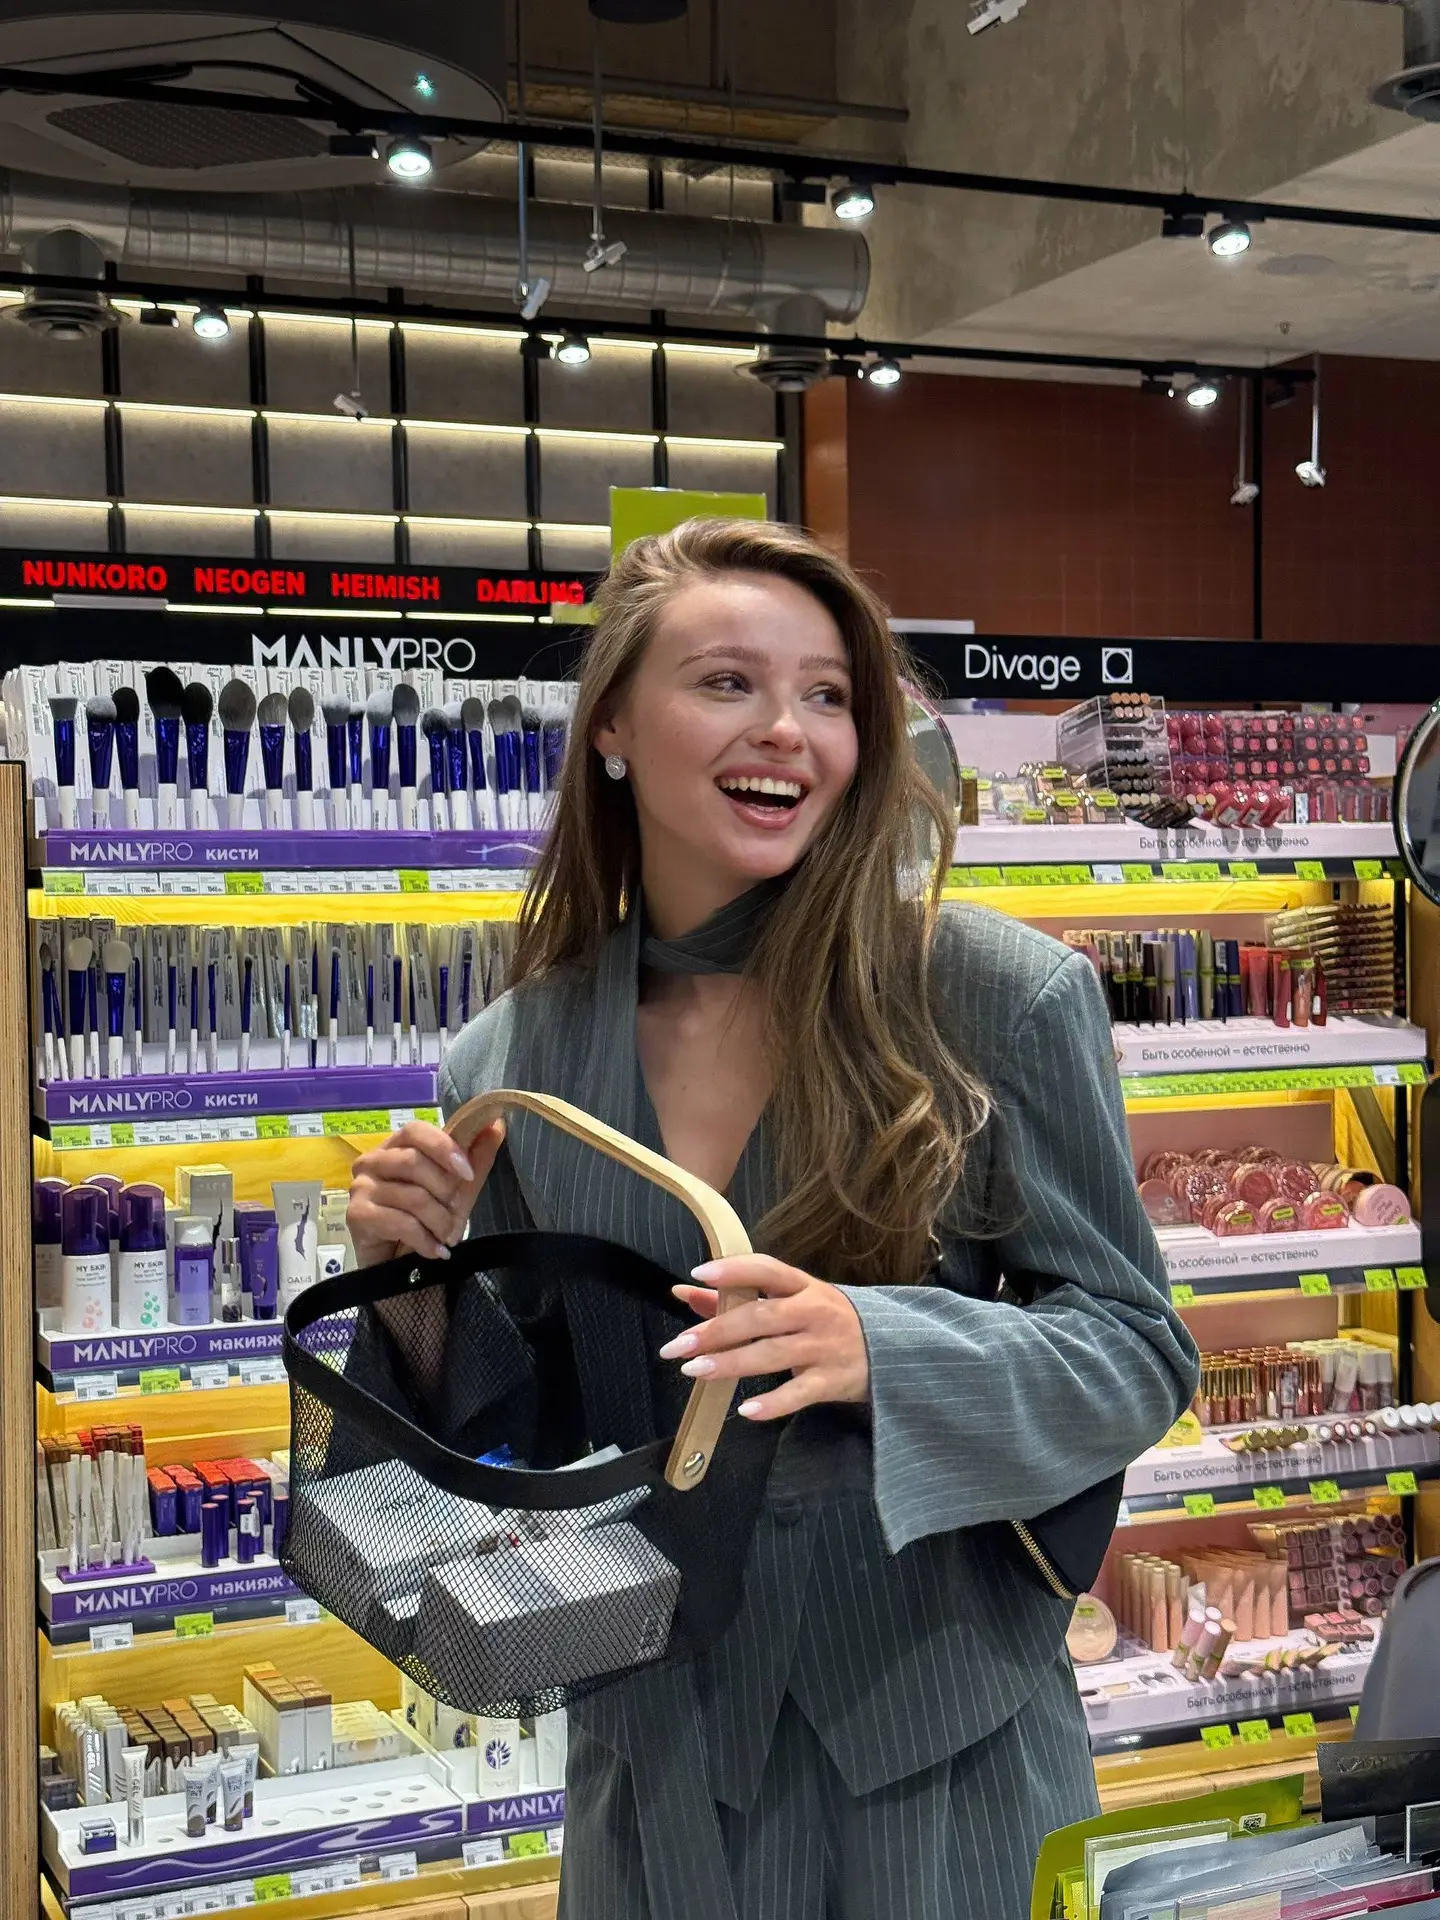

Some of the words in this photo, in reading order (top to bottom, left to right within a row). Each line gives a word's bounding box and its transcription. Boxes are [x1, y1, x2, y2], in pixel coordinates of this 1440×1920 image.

[23, 561, 167, 591] NUNKORO
[194, 568, 305, 595] NEOGEN
[331, 573, 440, 600] HEIMISH
[477, 579, 585, 605] DARLING
[251, 634, 476, 673] MANLYPRO
[965, 644, 1081, 690] Divage
[70, 842, 194, 862] MANLYPRO
[205, 848, 259, 861] кисти
[1139, 836, 1168, 849] Быть
[1142, 1048, 1169, 1061] Быть
[1171, 1045, 1230, 1060] особенной
[1243, 1043, 1311, 1056] естественно
[68, 1089, 193, 1114] MANLYPRO
[205, 1093, 259, 1107] кисти
[1178, 1253, 1239, 1268] особенной
[1251, 1249, 1319, 1263] естественно
[74, 1334, 197, 1363] MANLYPRO
[209, 1333, 283, 1352] макияж
[1154, 1470, 1181, 1482] Быть
[75, 1580, 198, 1614] MANLYPRO
[210, 1576, 284, 1596] макияж
